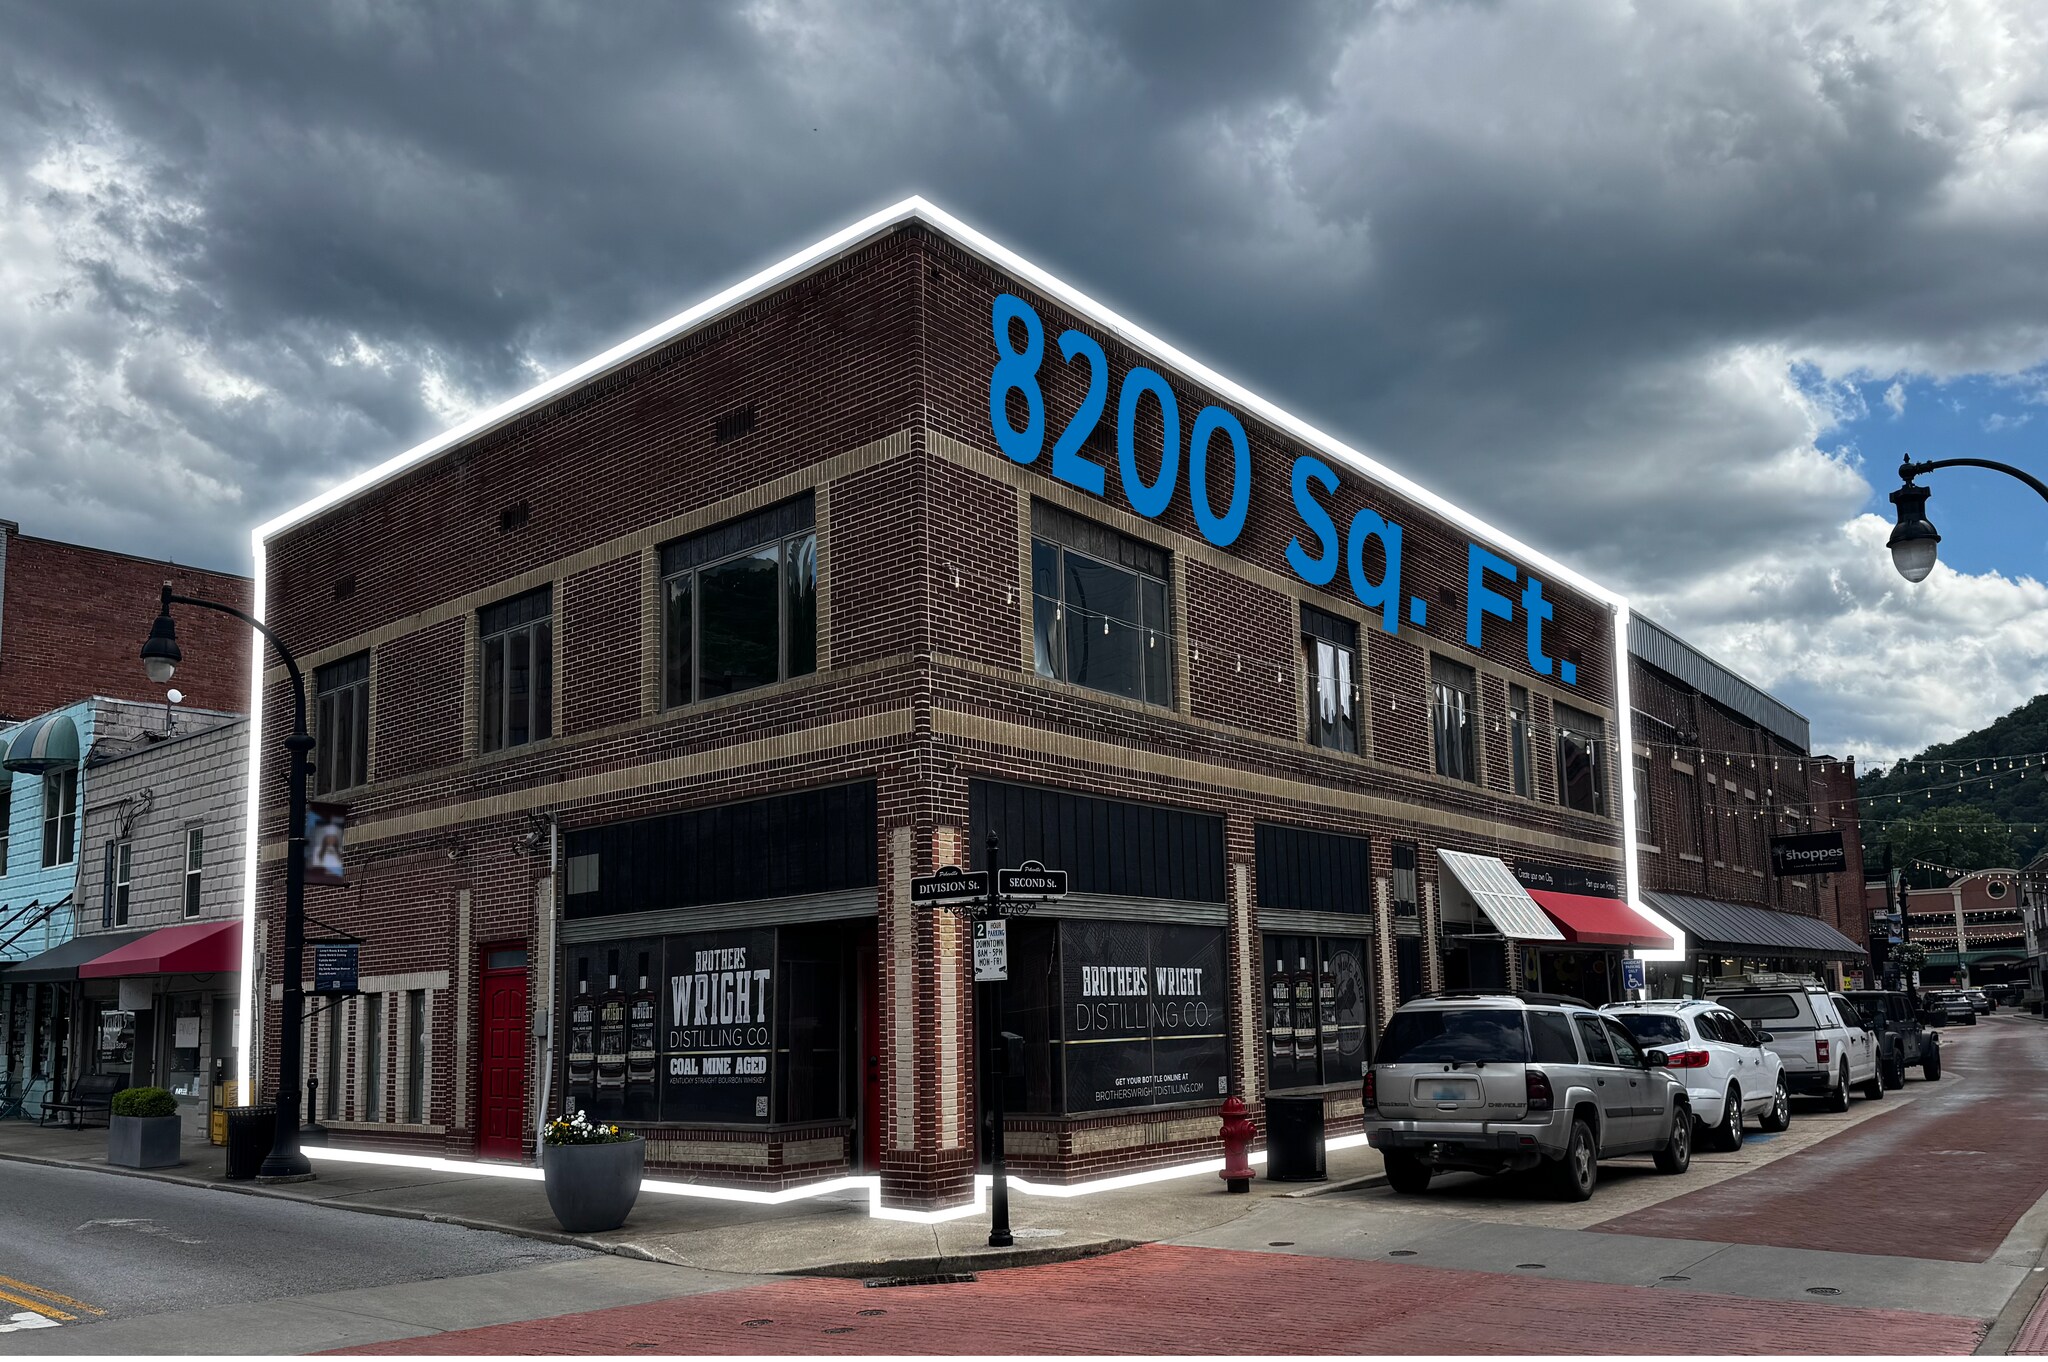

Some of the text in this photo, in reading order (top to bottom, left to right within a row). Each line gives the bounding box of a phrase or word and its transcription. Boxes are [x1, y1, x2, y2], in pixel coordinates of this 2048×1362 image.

[1786, 848, 1843, 861] shoppes
[919, 880, 980, 894] DIVISION St.
[1009, 877, 1057, 888] SECOND St.
[977, 923, 985, 937] 2
[976, 940, 1004, 948] DOWNTOWN
[695, 947, 746, 972] BROTHERS
[1082, 966, 1202, 997] BROTHERS WRIGHT
[671, 969, 771, 1026] WRIGHT
[1076, 1001, 1211, 1031] DISTILLING CO.
[670, 1027, 770, 1048] DISTILLING CO.
[670, 1056, 767, 1075] COAL MINE AGED
[744, 1076, 766, 1084] WHISKEY
[1115, 1078, 1126, 1086] GET
[1142, 1075, 1163, 1084] BOTTLE
[1164, 1074, 1181, 1082] ONLINE
